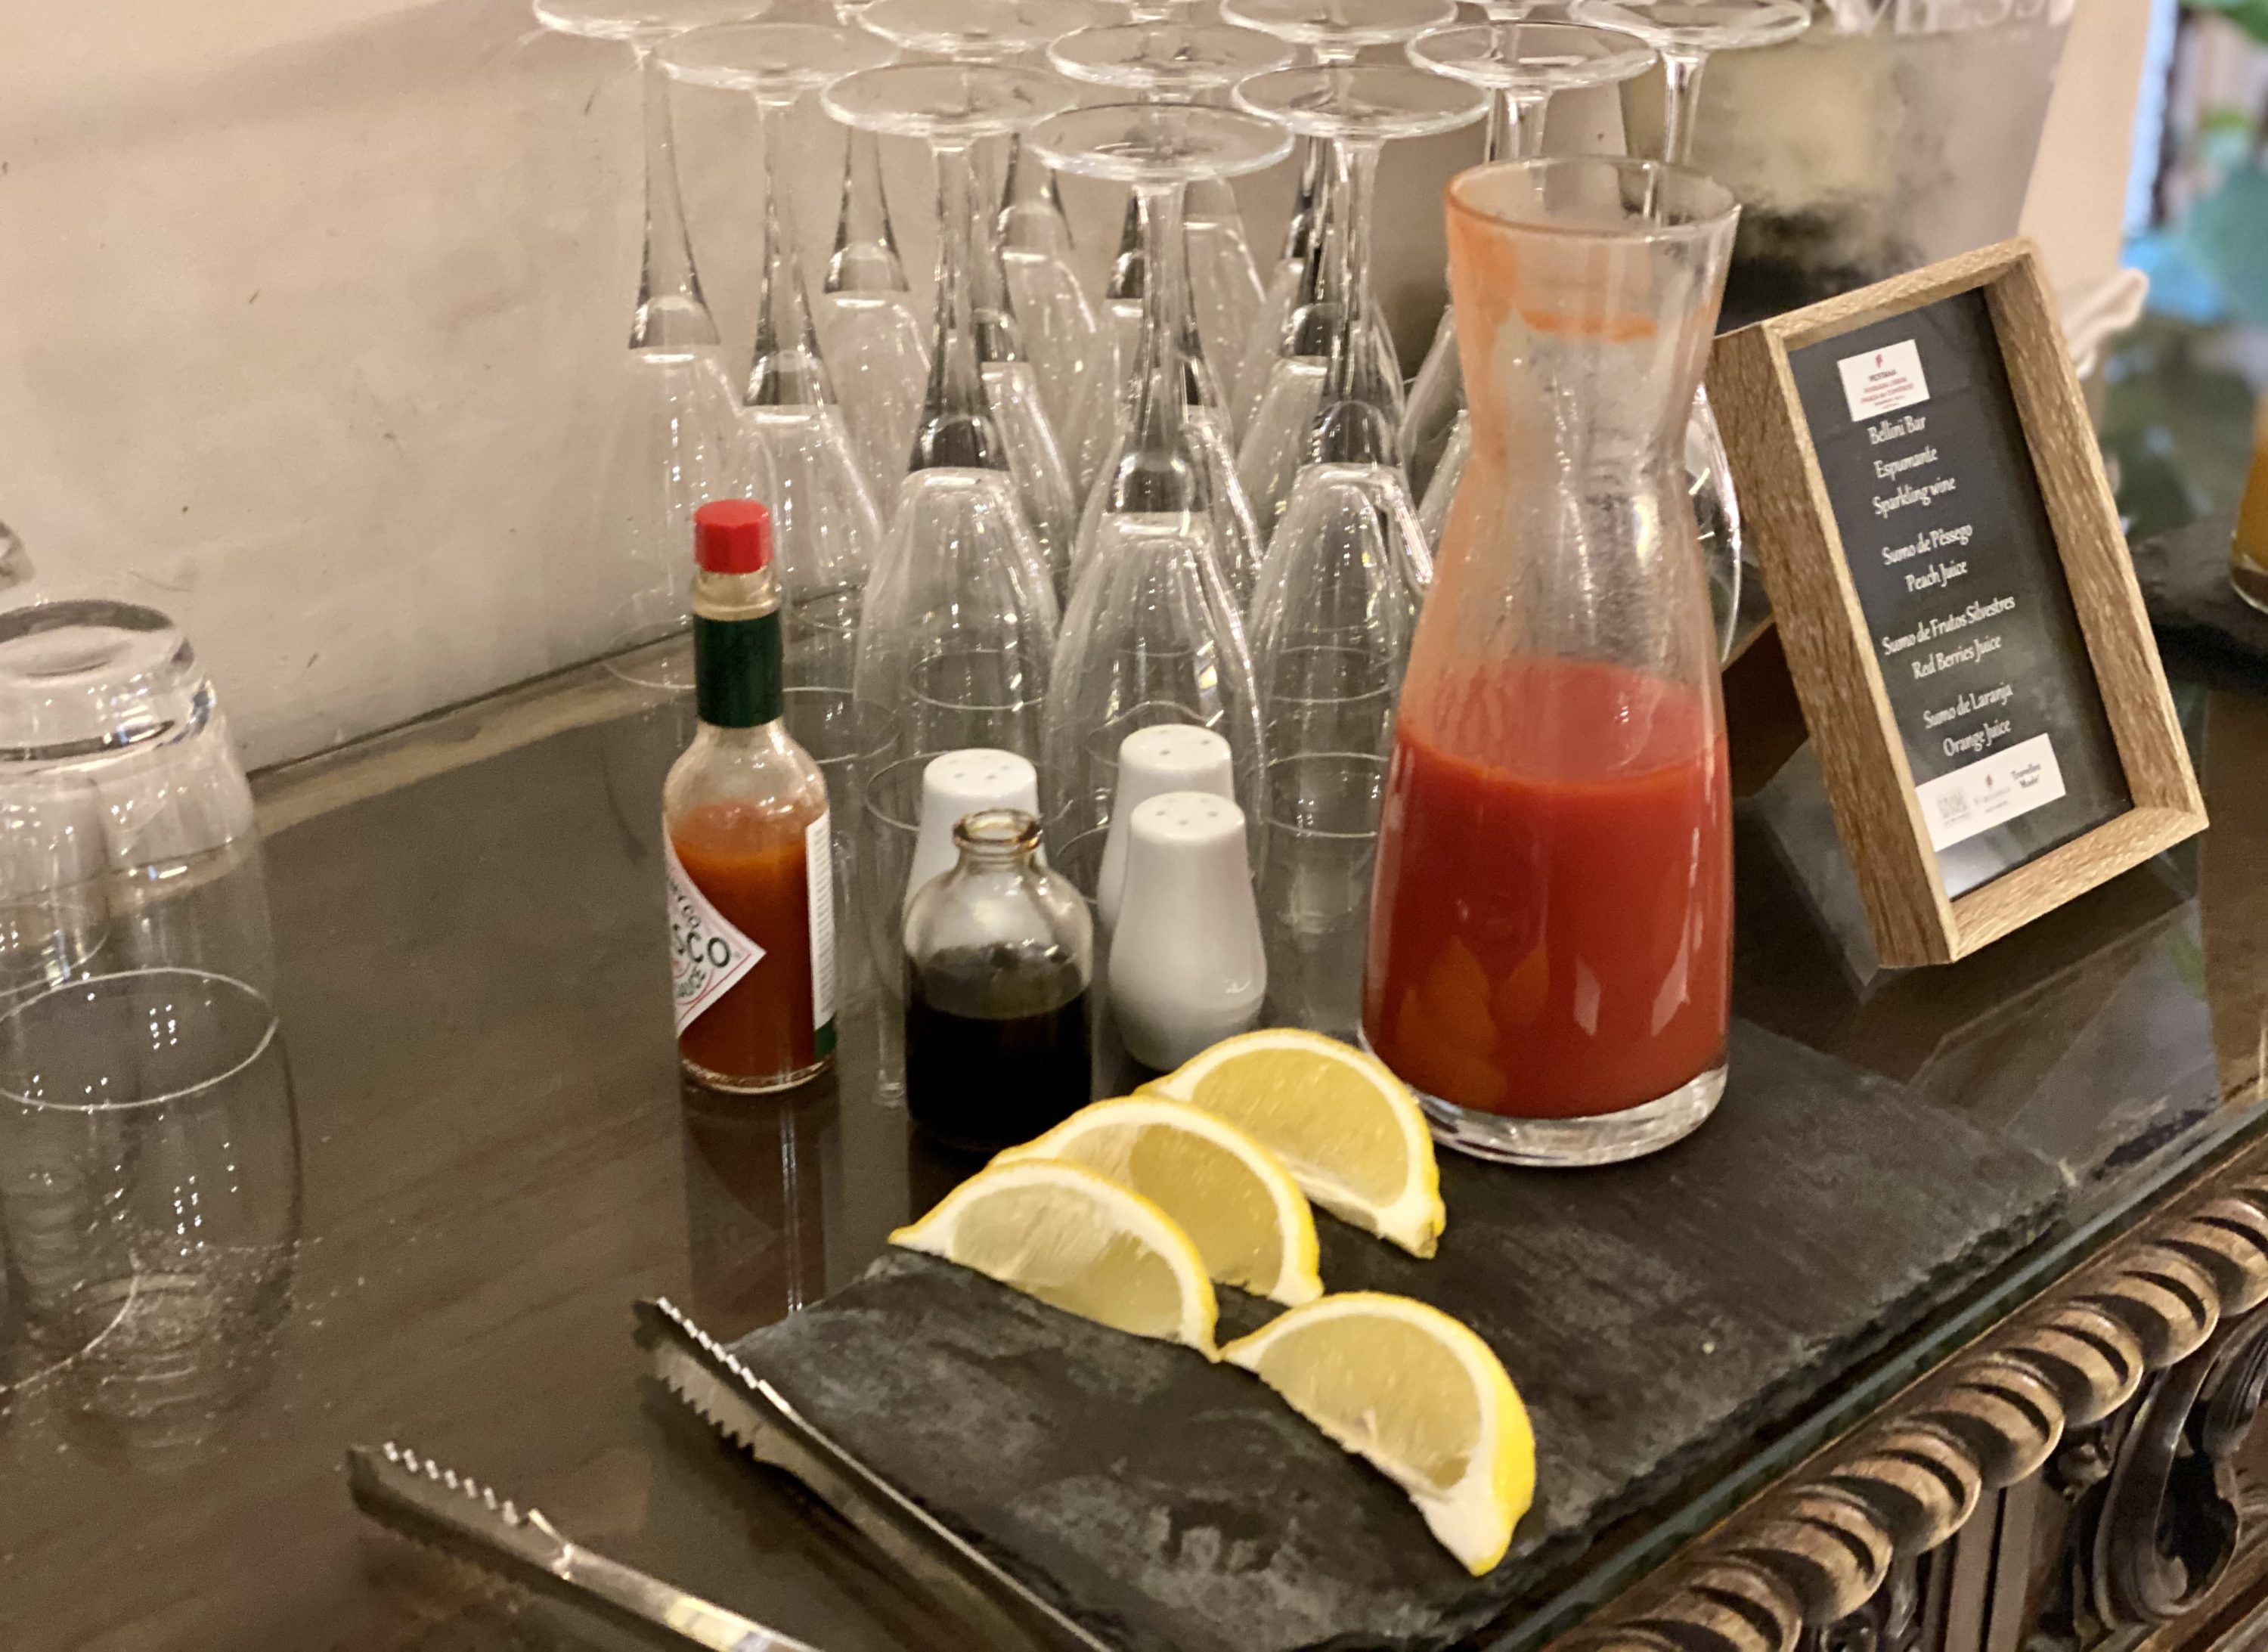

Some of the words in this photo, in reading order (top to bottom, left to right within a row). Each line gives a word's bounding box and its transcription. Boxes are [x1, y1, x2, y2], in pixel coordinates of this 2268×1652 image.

[1867, 420, 1906, 445] Bellini
[1903, 416, 1926, 433] Bar
[1873, 446, 1938, 481] Espumante
[1872, 484, 1931, 519] Sparkling
[1928, 476, 1956, 495] wine
[1882, 544, 1916, 565] Sumo
[1916, 532, 1931, 553] de
[1929, 525, 1973, 548] Pêssego
[1904, 564, 1941, 592] Peach
[1938, 560, 1968, 587] Juice
[1882, 634, 1916, 656] Sumo
[1916, 621, 1931, 643] de
[1929, 614, 1966, 637] Frutos
[1966, 597, 2015, 624] Silvestres
[1911, 653, 1936, 679] Red
[1935, 646, 1975, 671] Berries
[1973, 635, 2002, 662] Juice
[1923, 707, 1957, 729] Sumo
[1957, 693, 1972, 716] de
[1969, 681, 2014, 710] Laranja
[1943, 730, 1985, 756] Orange
[1983, 719, 2012, 746] Juice
